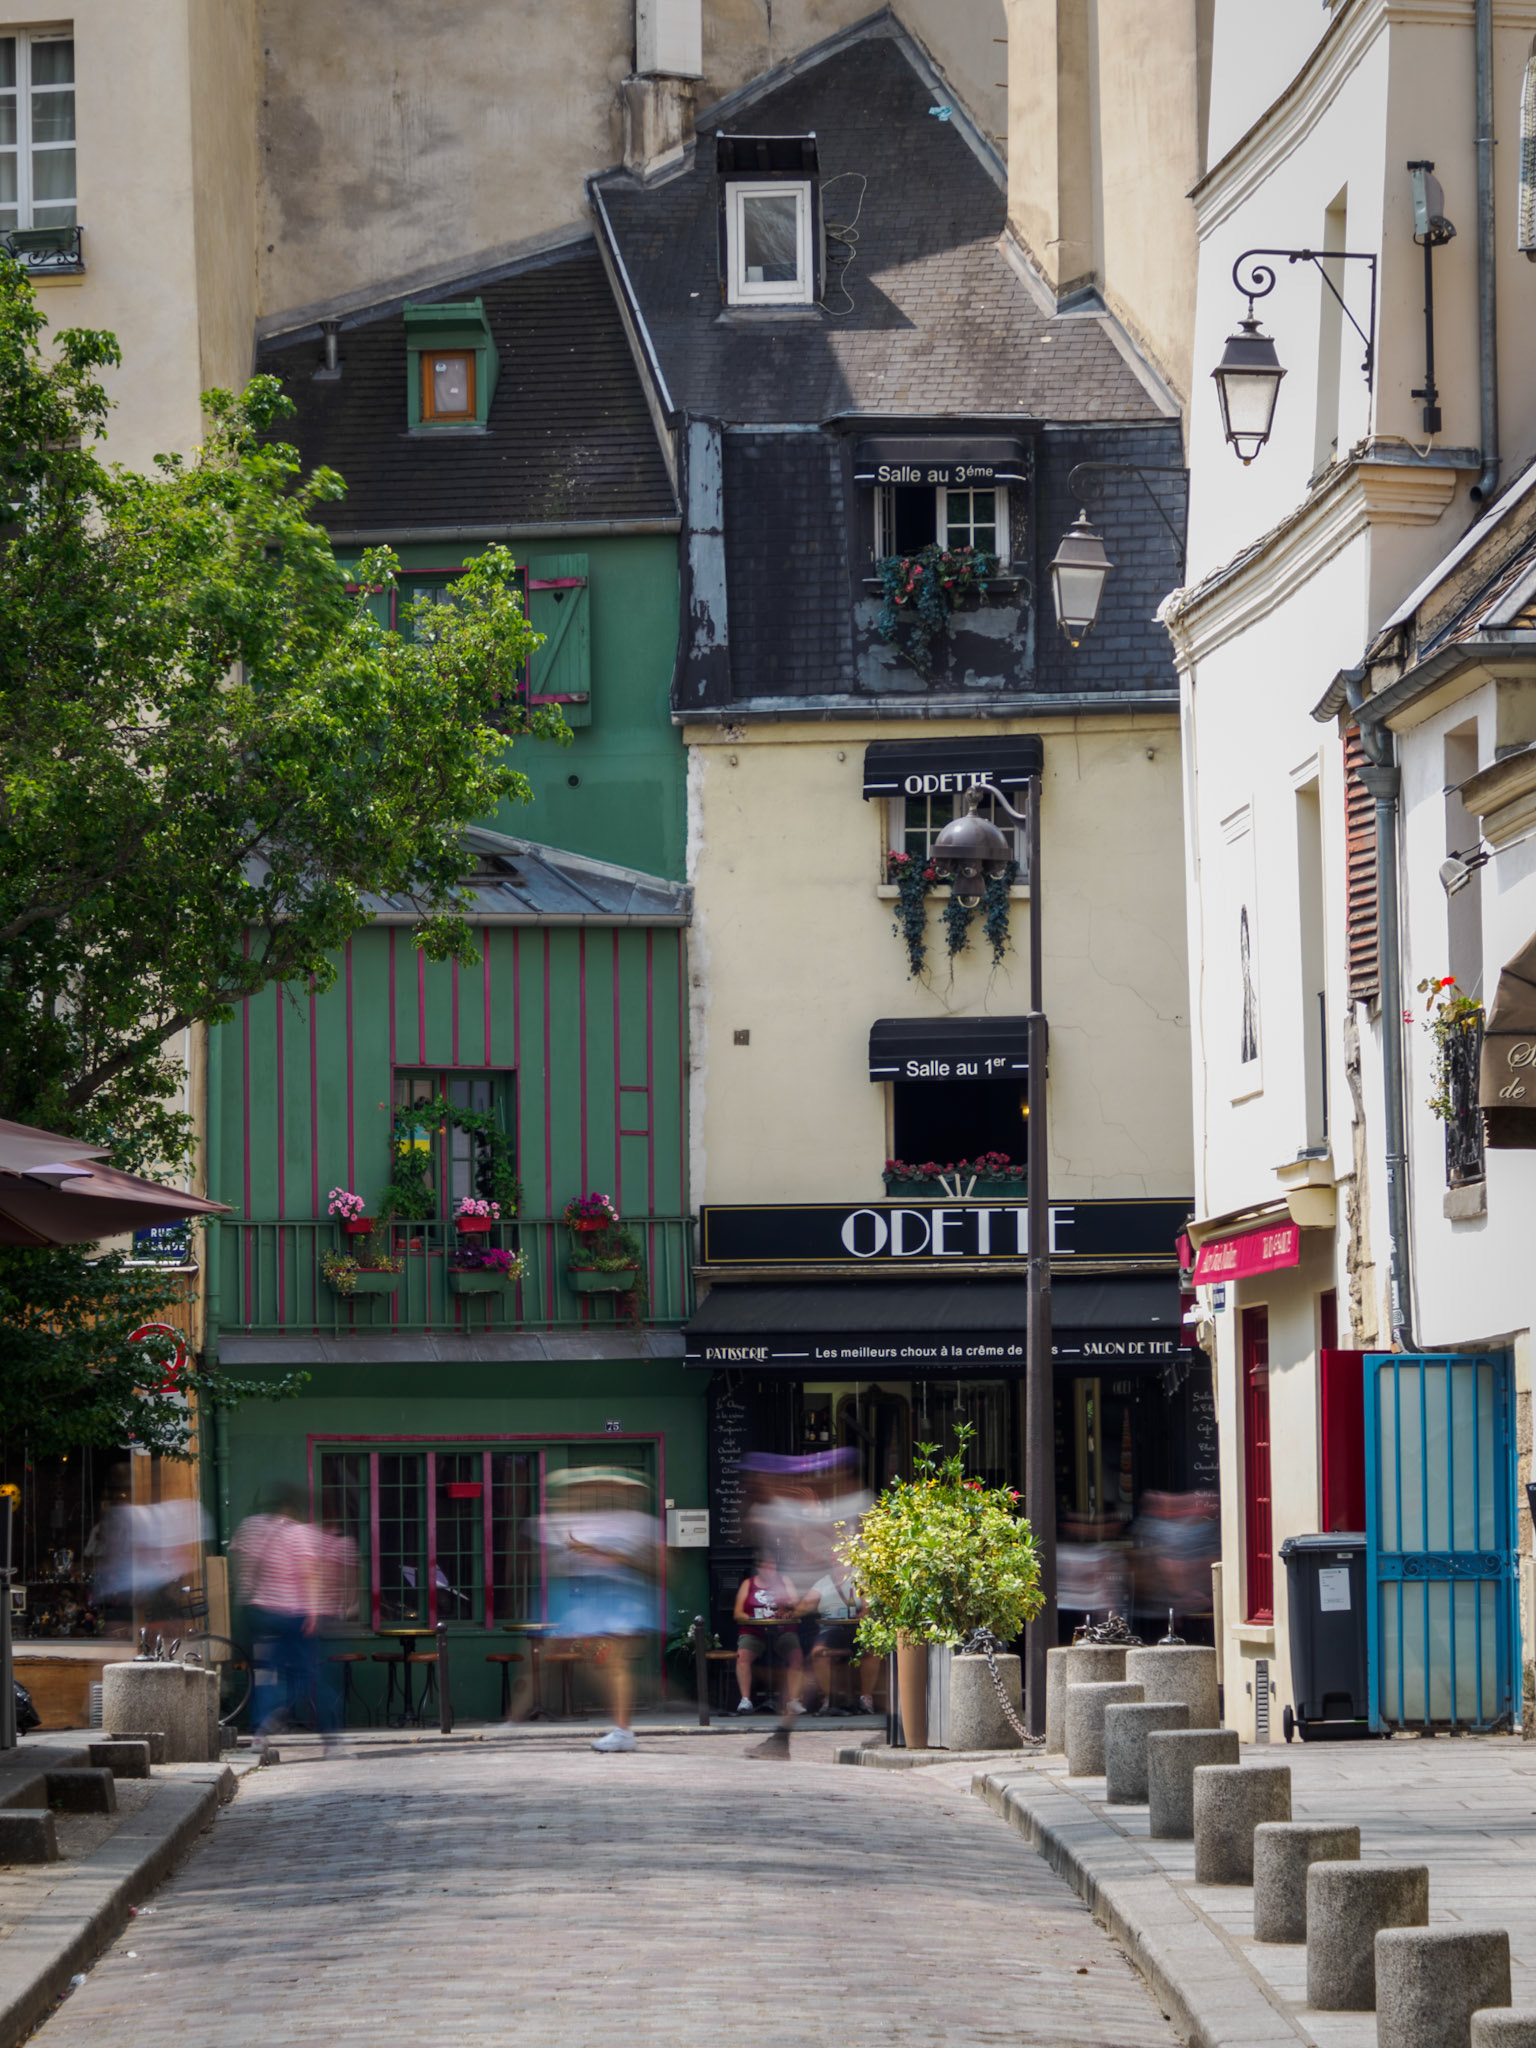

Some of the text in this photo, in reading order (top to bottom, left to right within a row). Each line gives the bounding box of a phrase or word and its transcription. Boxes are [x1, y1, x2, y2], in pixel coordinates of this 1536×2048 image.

[877, 465, 921, 483] Salle
[927, 469, 949, 483] au
[904, 772, 993, 794] ODETTE
[906, 1058, 1006, 1077] Salle au 1er
[1499, 1077, 1525, 1099] de
[150, 1227, 173, 1238] RUE
[841, 1206, 1075, 1258] ODETTE
[706, 1347, 769, 1362] PATISSERIE
[815, 1347, 838, 1358] Les
[841, 1346, 897, 1358] meilleurs
[900, 1346, 937, 1357] choux
[940, 1345, 948, 1356] à
[952, 1345, 963, 1356] la
[1007, 1344, 1023, 1355] de
[1083, 1341, 1173, 1356] SALON DE THE
[607, 1421, 620, 1431] 75
